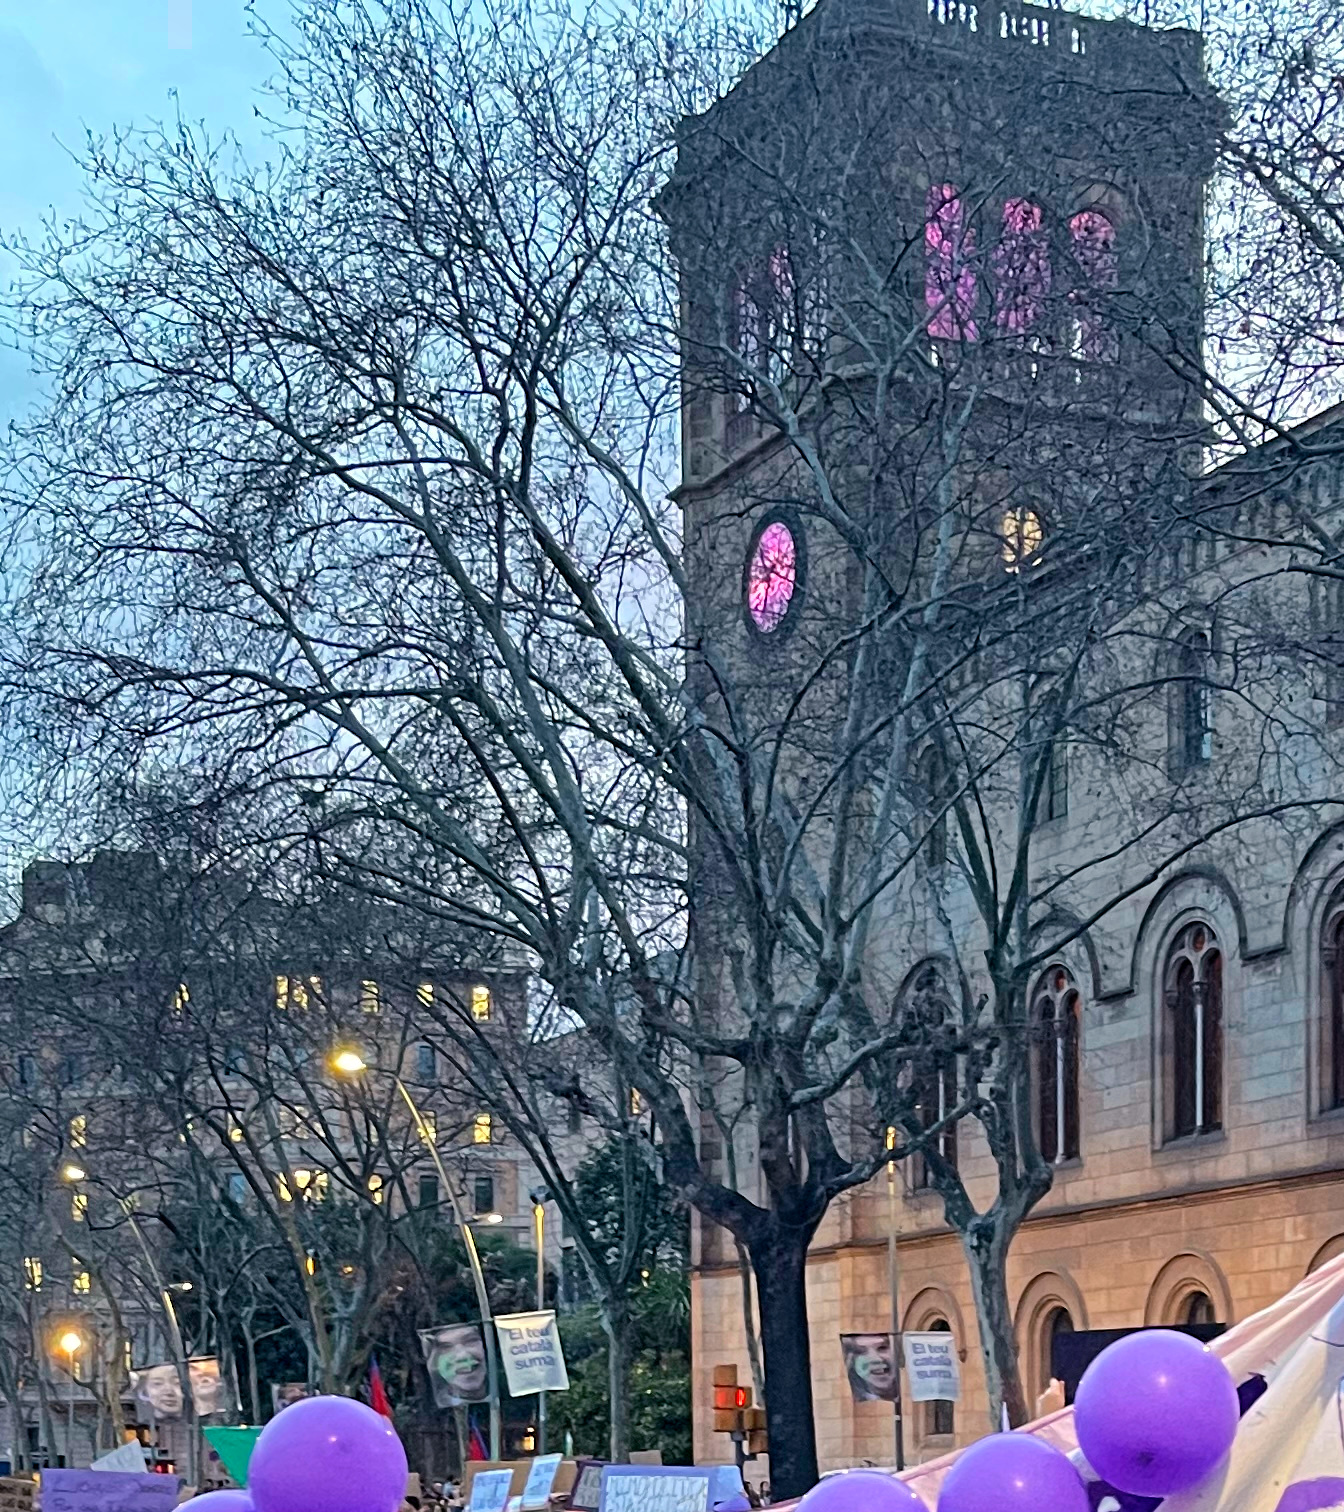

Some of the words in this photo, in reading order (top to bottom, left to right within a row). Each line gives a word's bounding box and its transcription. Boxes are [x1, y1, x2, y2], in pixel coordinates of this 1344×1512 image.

[509, 1327, 524, 1340] El
[511, 1339, 553, 1355] català
[911, 1342, 926, 1354] El
[515, 1355, 555, 1370] suma
